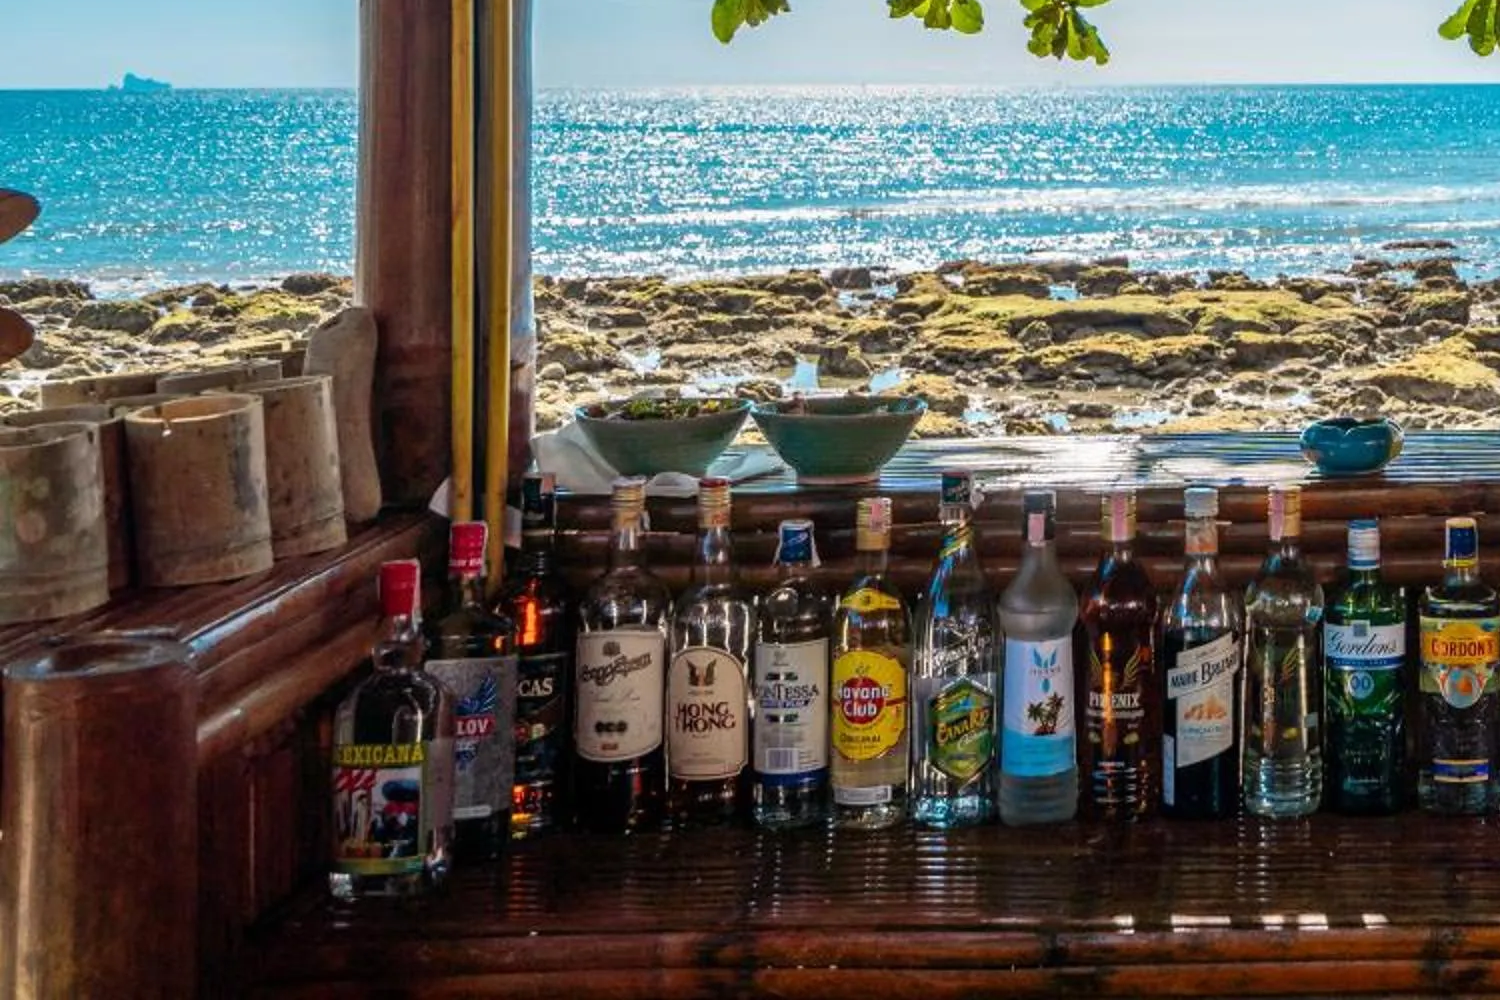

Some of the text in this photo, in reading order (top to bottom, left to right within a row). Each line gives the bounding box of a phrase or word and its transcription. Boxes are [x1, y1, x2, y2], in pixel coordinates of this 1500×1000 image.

[836, 681, 889, 699] Havana
[843, 699, 878, 718] Club
[1088, 691, 1141, 709] PHENIX
[676, 701, 729, 721] HONG
[674, 715, 737, 734] THONG
